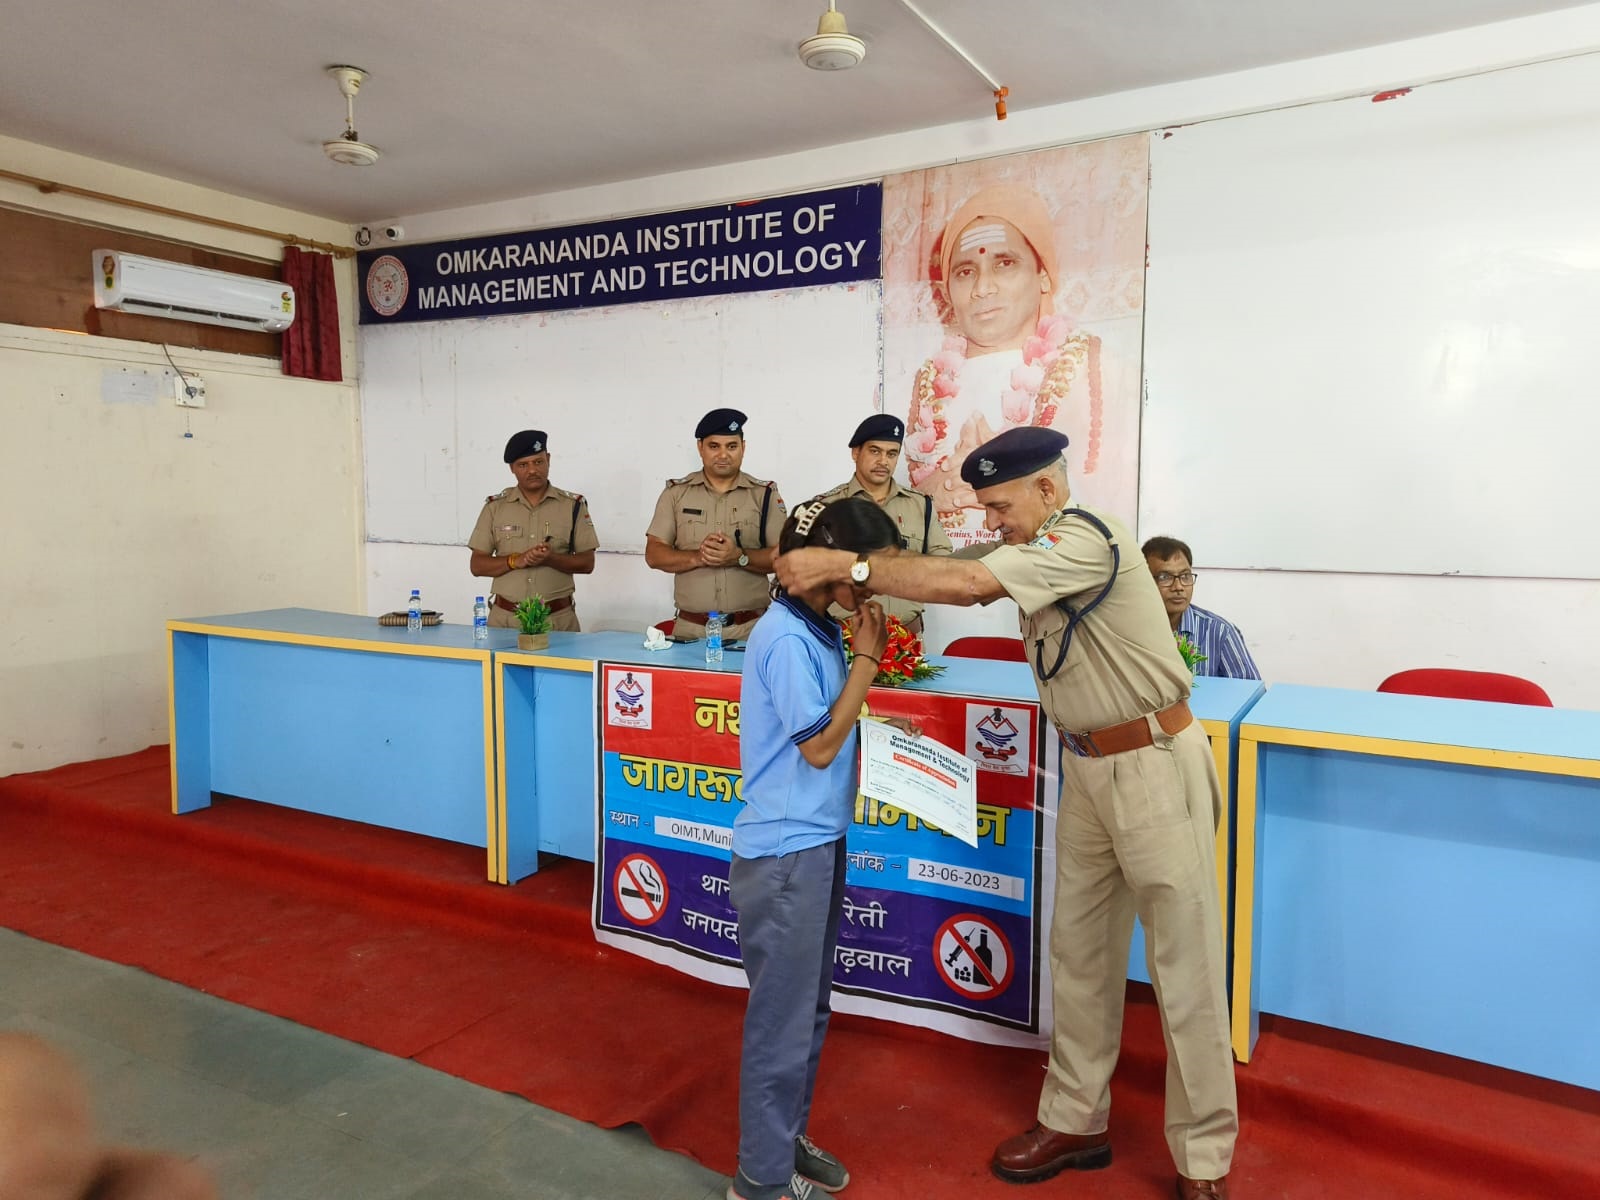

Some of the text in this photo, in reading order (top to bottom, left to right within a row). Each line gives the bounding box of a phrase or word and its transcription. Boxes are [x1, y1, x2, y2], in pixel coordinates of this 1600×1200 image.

[436, 203, 836, 276] OMKARANANDA INSTITUTE OF
[418, 271, 585, 310] MANAGEMENT
[590, 265, 646, 294] AND
[654, 239, 867, 287] TECHNOLOGY
[889, 740, 931, 760] Management
[619, 752, 744, 803] जागरू
[609, 811, 640, 827] स्थान
[671, 823, 733, 847] OIMT,Muni
[918, 863, 1000, 890] 23-06-2023
[681, 908, 739, 945] जनपद
